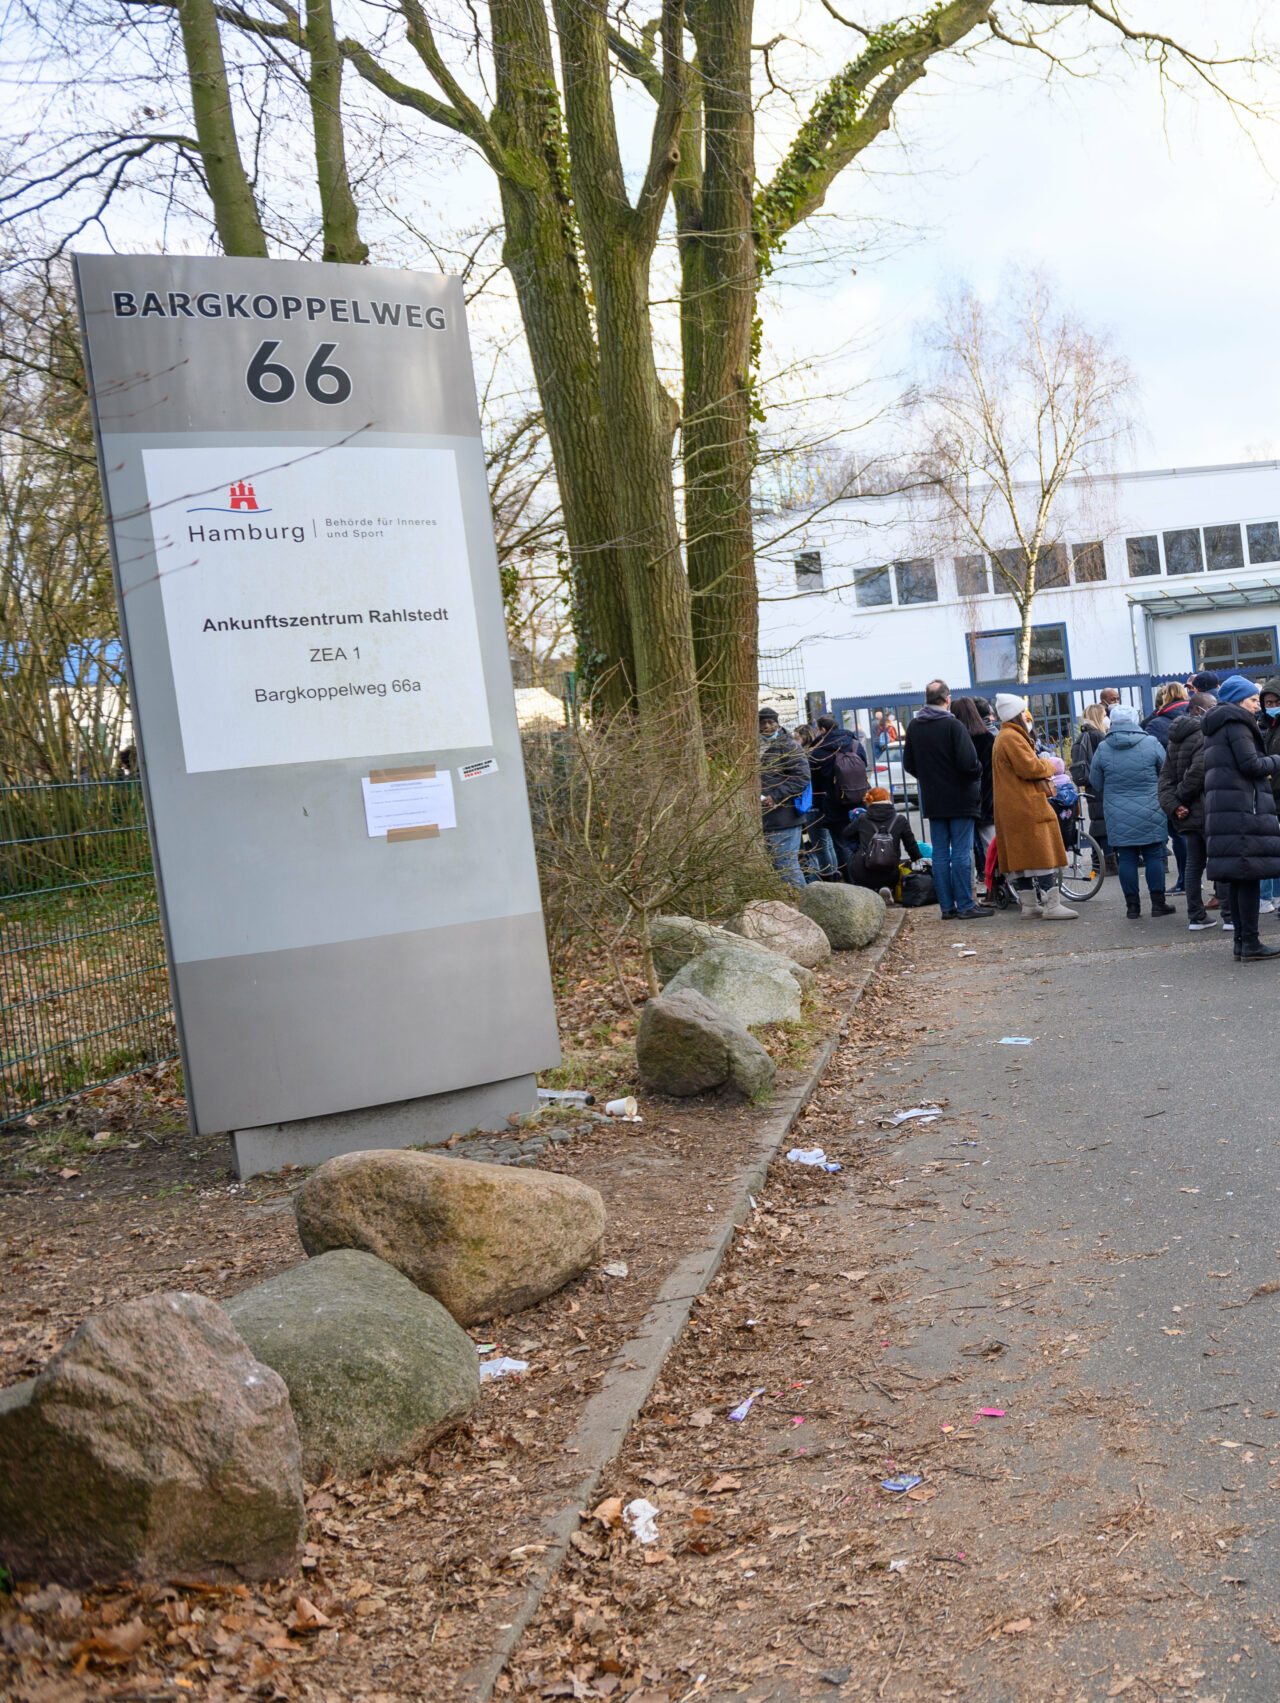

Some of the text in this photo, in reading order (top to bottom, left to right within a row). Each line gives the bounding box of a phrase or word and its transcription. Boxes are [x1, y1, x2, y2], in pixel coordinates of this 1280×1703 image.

[111, 291, 447, 331] BARGKOPPELWEG
[245, 339, 353, 405] 66
[188, 523, 306, 543] Hamburg
[326, 517, 437, 527] Behörde für Inneres
[327, 529, 384, 540] und Sport
[202, 608, 449, 632] Ankunftszentrum Rahlstedt
[309, 646, 361, 663] ZEA 1
[255, 678, 422, 704] Bargkoppelweg 66a
